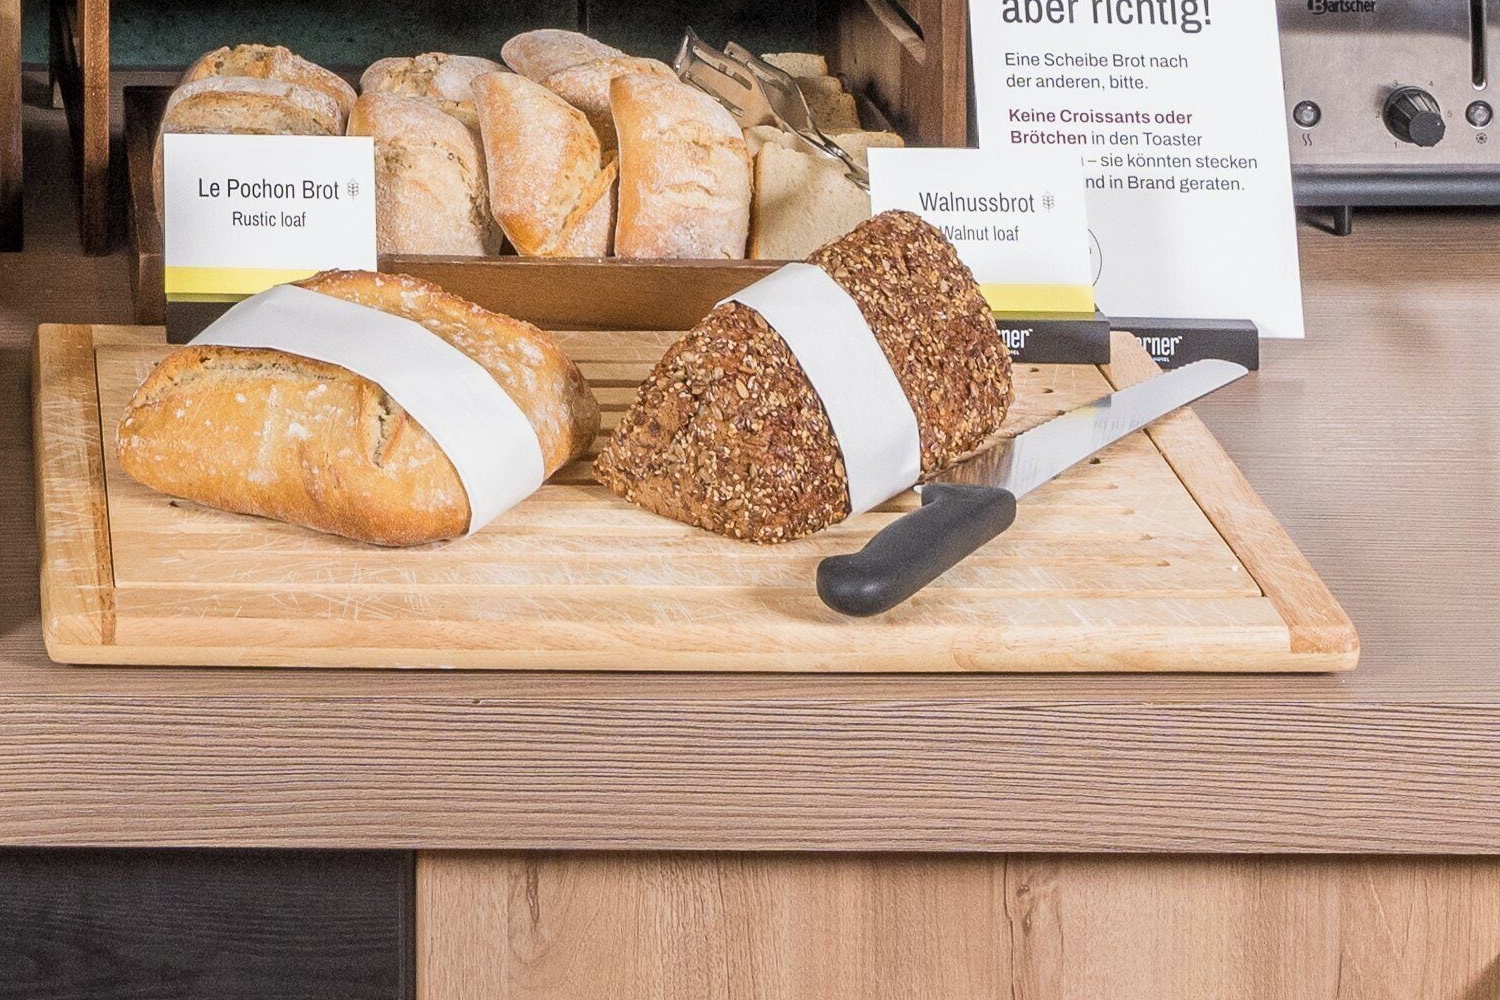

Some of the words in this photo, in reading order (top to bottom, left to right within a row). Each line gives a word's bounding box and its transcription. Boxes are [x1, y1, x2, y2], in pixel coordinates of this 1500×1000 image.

[1004, 52, 1040, 67] Eine
[1043, 52, 1109, 68] Scheibe
[1112, 53, 1146, 68] Brot
[1149, 53, 1189, 69] nach
[1005, 73, 1033, 88] der
[1035, 74, 1105, 91] anderen,
[1109, 74, 1149, 90] bitte.
[1008, 108, 1056, 123] Keine
[1059, 108, 1151, 124] Croissants
[1154, 110, 1193, 125] oder
[1010, 129, 1087, 145] Brötchen
[1091, 131, 1106, 145] in
[1109, 131, 1139, 146] den
[1142, 131, 1203, 147] Toaster
[1100, 152, 1124, 168] sie
[1126, 153, 1192, 168] könnten
[1195, 154, 1258, 169] stecken
[198, 177, 220, 198] Le
[227, 178, 295, 199] Pochon
[302, 179, 340, 200] Brot
[1085, 174, 1105, 189] nd
[1109, 175, 1124, 190] in
[1127, 175, 1176, 190] Brand
[1179, 176, 1245, 194] geraten.
[918, 191, 1036, 213] Walnussbrot
[232, 210, 277, 227] Rustic
[280, 211, 307, 228] loaf
[939, 224, 990, 242] Walnut
[992, 225, 1019, 242] loaf
